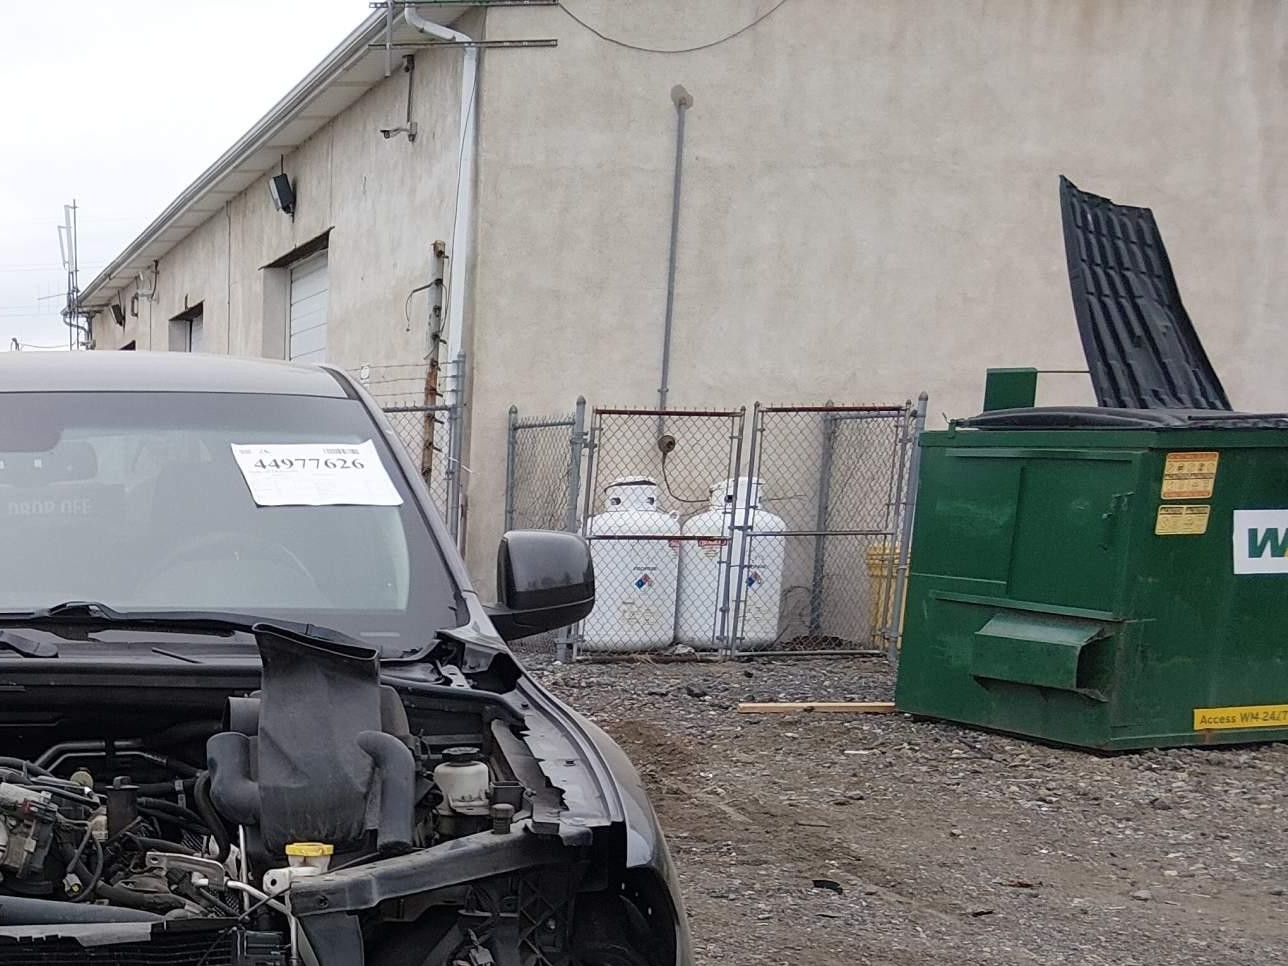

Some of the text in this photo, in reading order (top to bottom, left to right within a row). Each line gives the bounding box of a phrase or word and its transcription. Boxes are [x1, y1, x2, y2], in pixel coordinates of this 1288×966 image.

[254, 458, 365, 470] 44977626
[1200, 710, 1288, 725] Access WM 24/7
